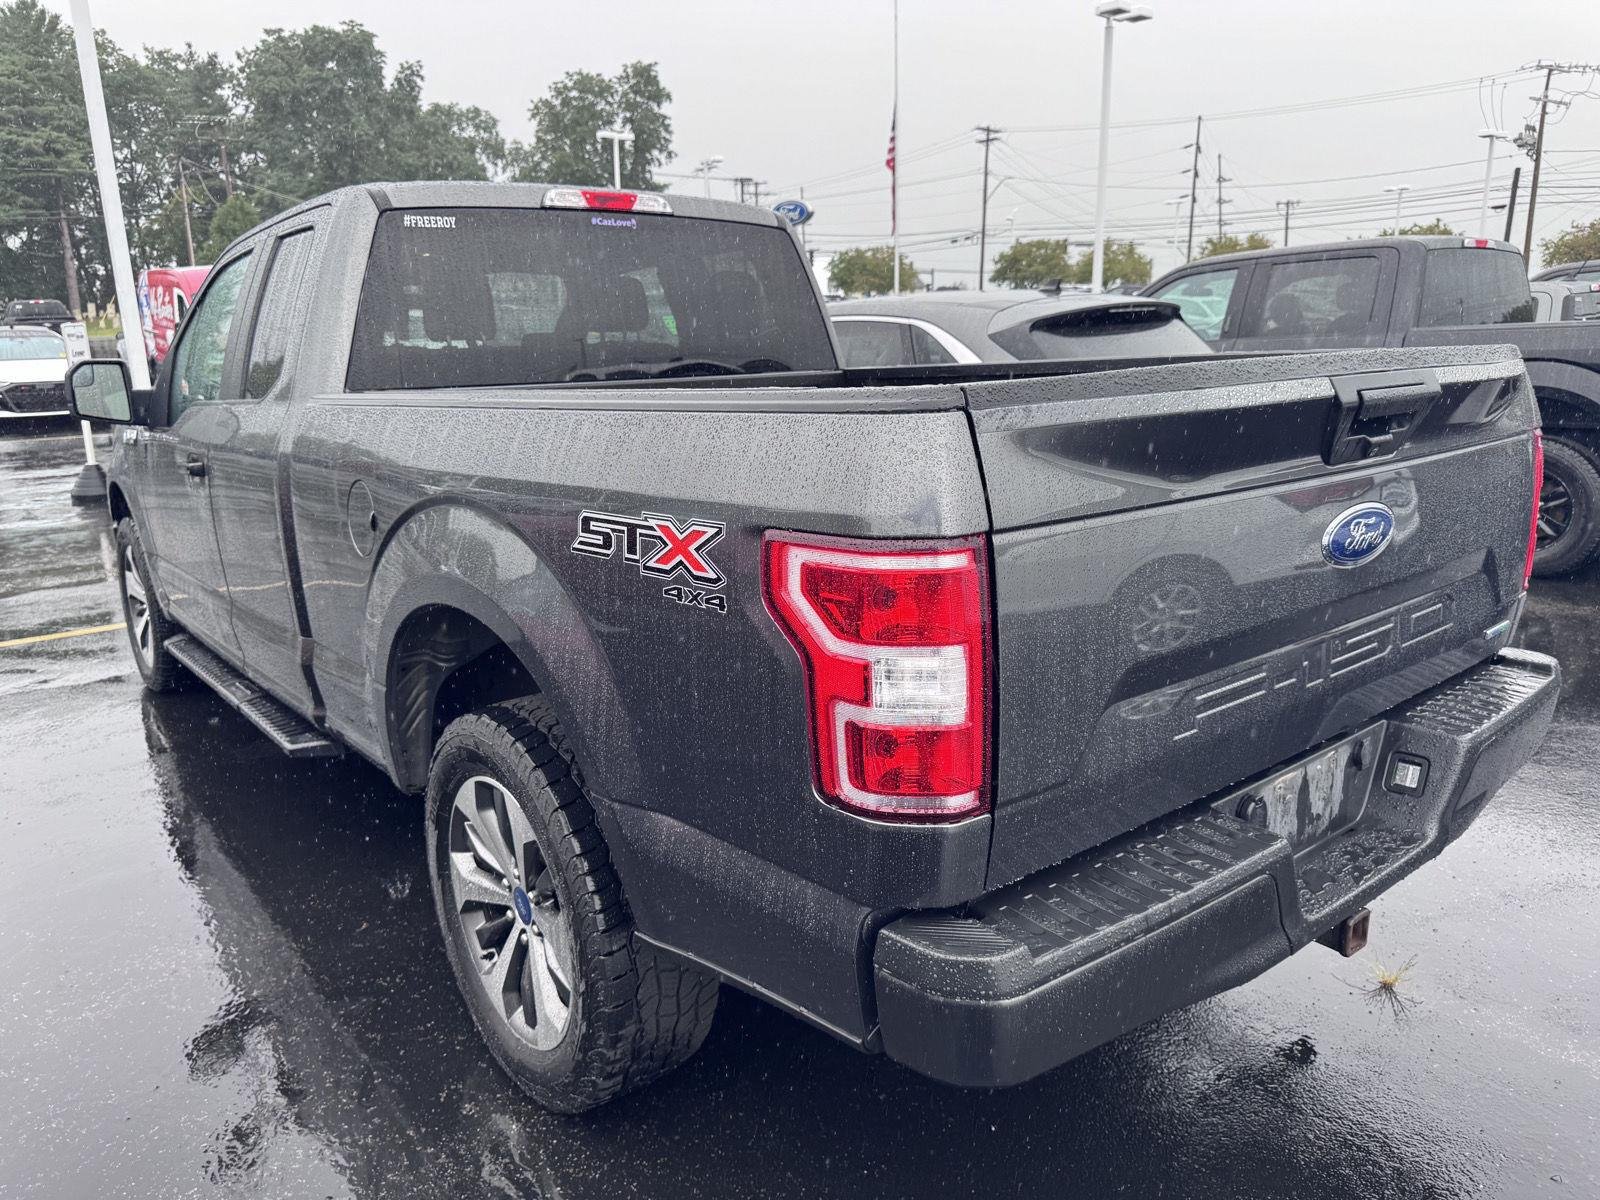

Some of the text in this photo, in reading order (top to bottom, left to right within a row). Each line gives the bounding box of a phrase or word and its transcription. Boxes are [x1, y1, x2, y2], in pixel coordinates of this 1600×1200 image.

[403, 214, 456, 228] #FREEROY
[571, 509, 727, 589] STX
[1345, 516, 1384, 553] Ford
[1172, 597, 1456, 741] F-150
